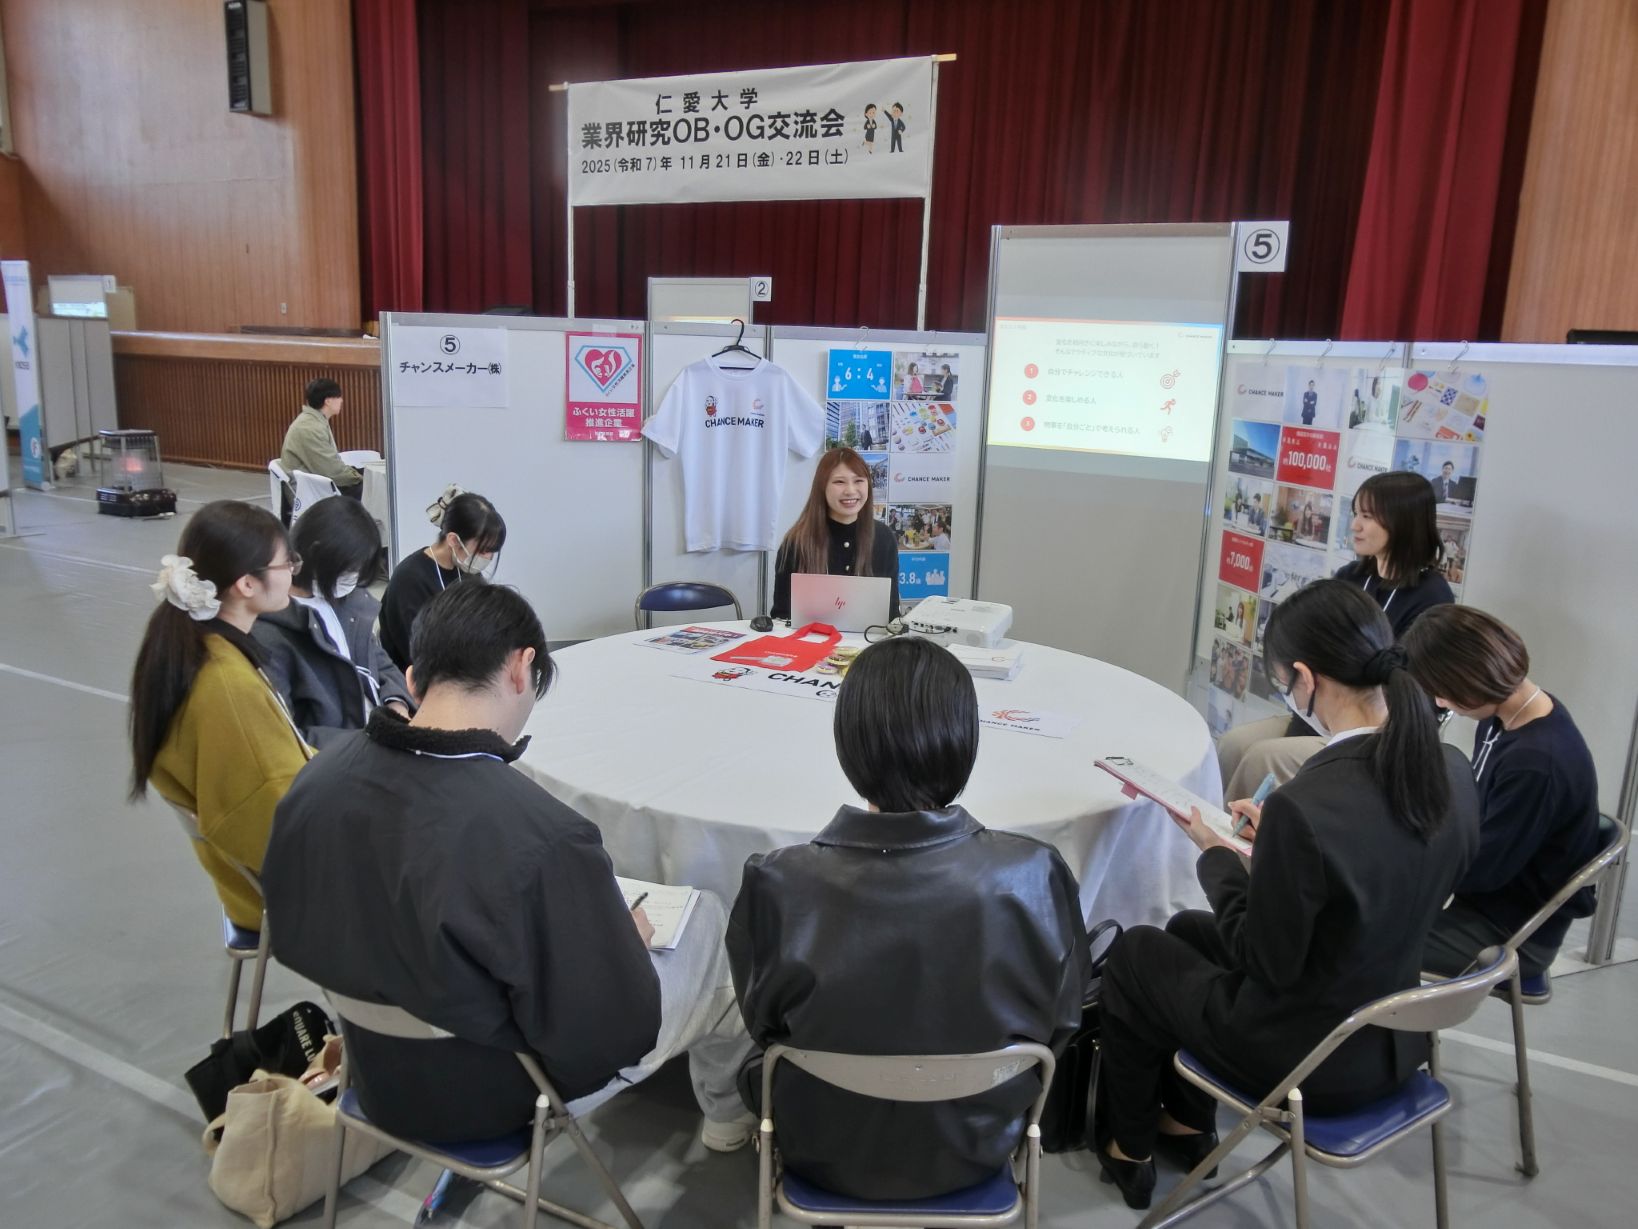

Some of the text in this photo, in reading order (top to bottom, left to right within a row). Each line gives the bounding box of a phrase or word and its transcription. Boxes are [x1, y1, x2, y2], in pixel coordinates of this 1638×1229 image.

[655, 87, 759, 115] 仁愛大学
[581, 108, 846, 149] 業界研究OB・OG交流会
[572, 406, 635, 418] ふくい女性活躍
[705, 416, 765, 429] CHANCE MAKER
